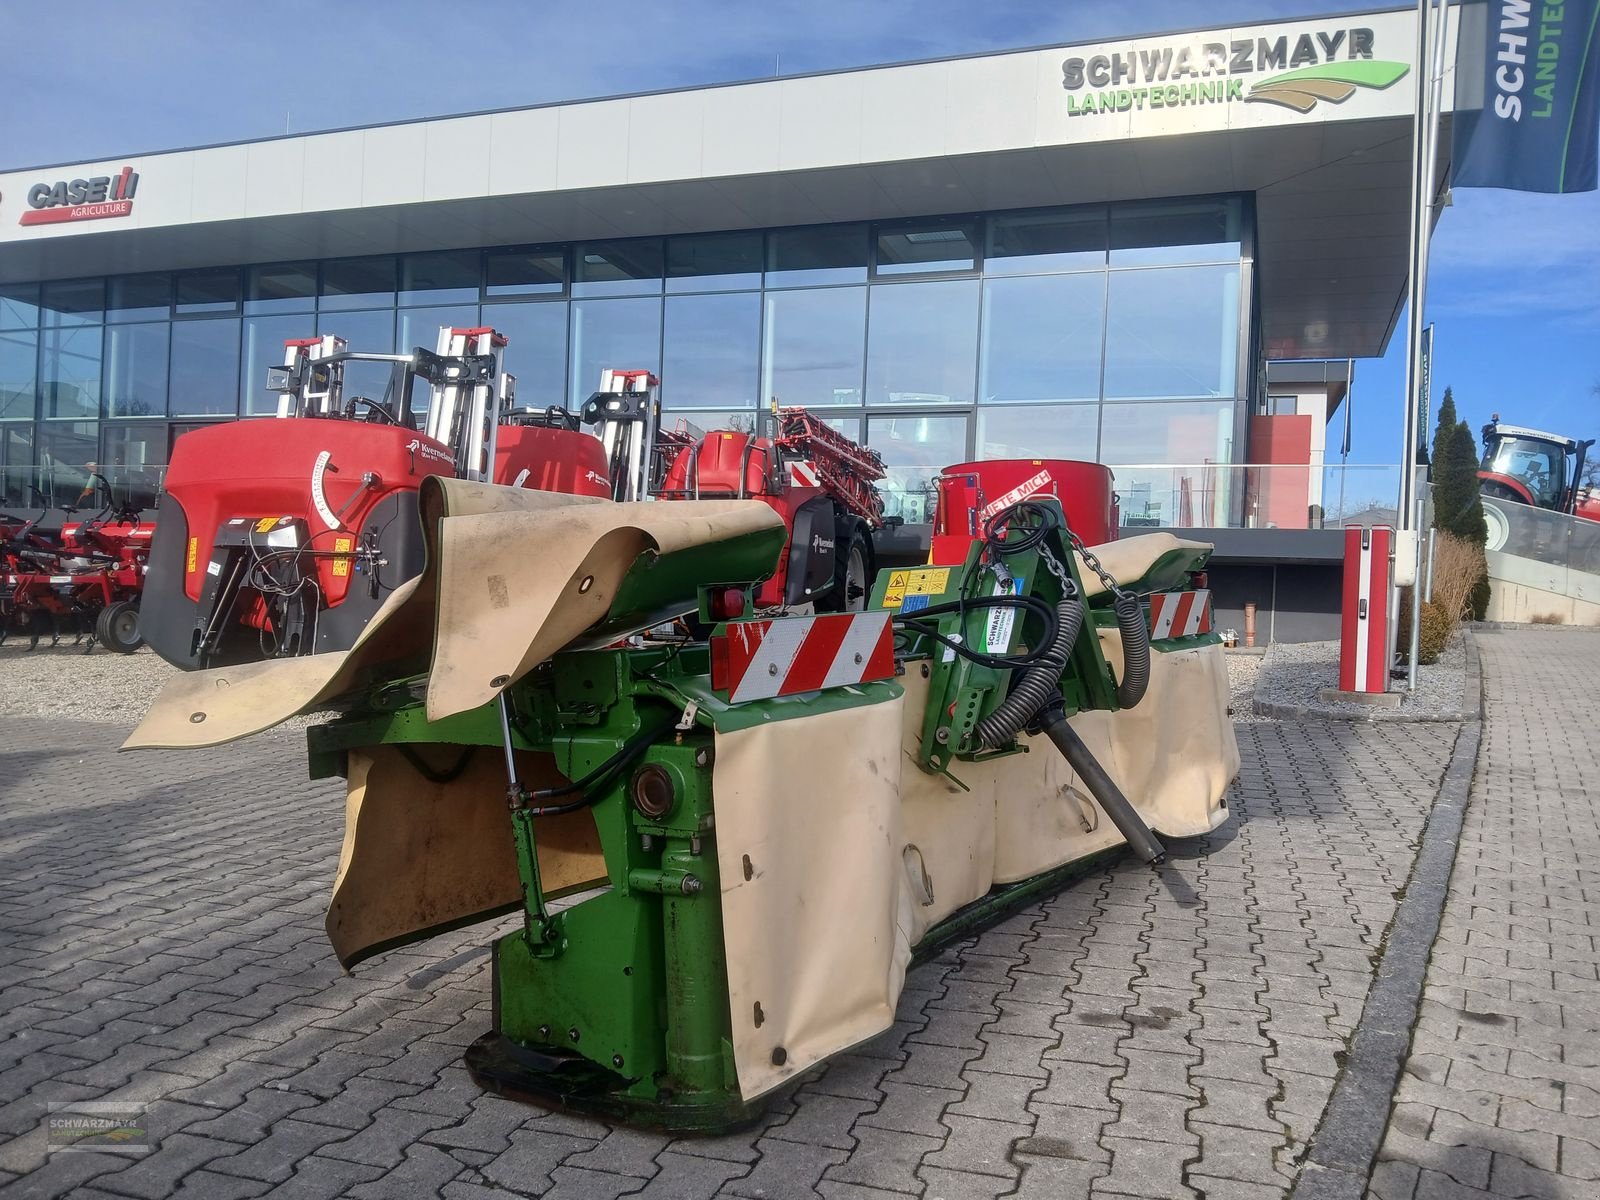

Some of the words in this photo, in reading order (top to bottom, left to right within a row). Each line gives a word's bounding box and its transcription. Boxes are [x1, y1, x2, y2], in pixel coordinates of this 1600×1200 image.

[1062, 28, 1375, 89] SCHWARZMAYR
[1067, 79, 1244, 117] LANDTECHNIK
[27, 176, 110, 209] CASE
[70, 202, 126, 218] AGRICULTURE
[1017, 471, 1051, 498] MICH
